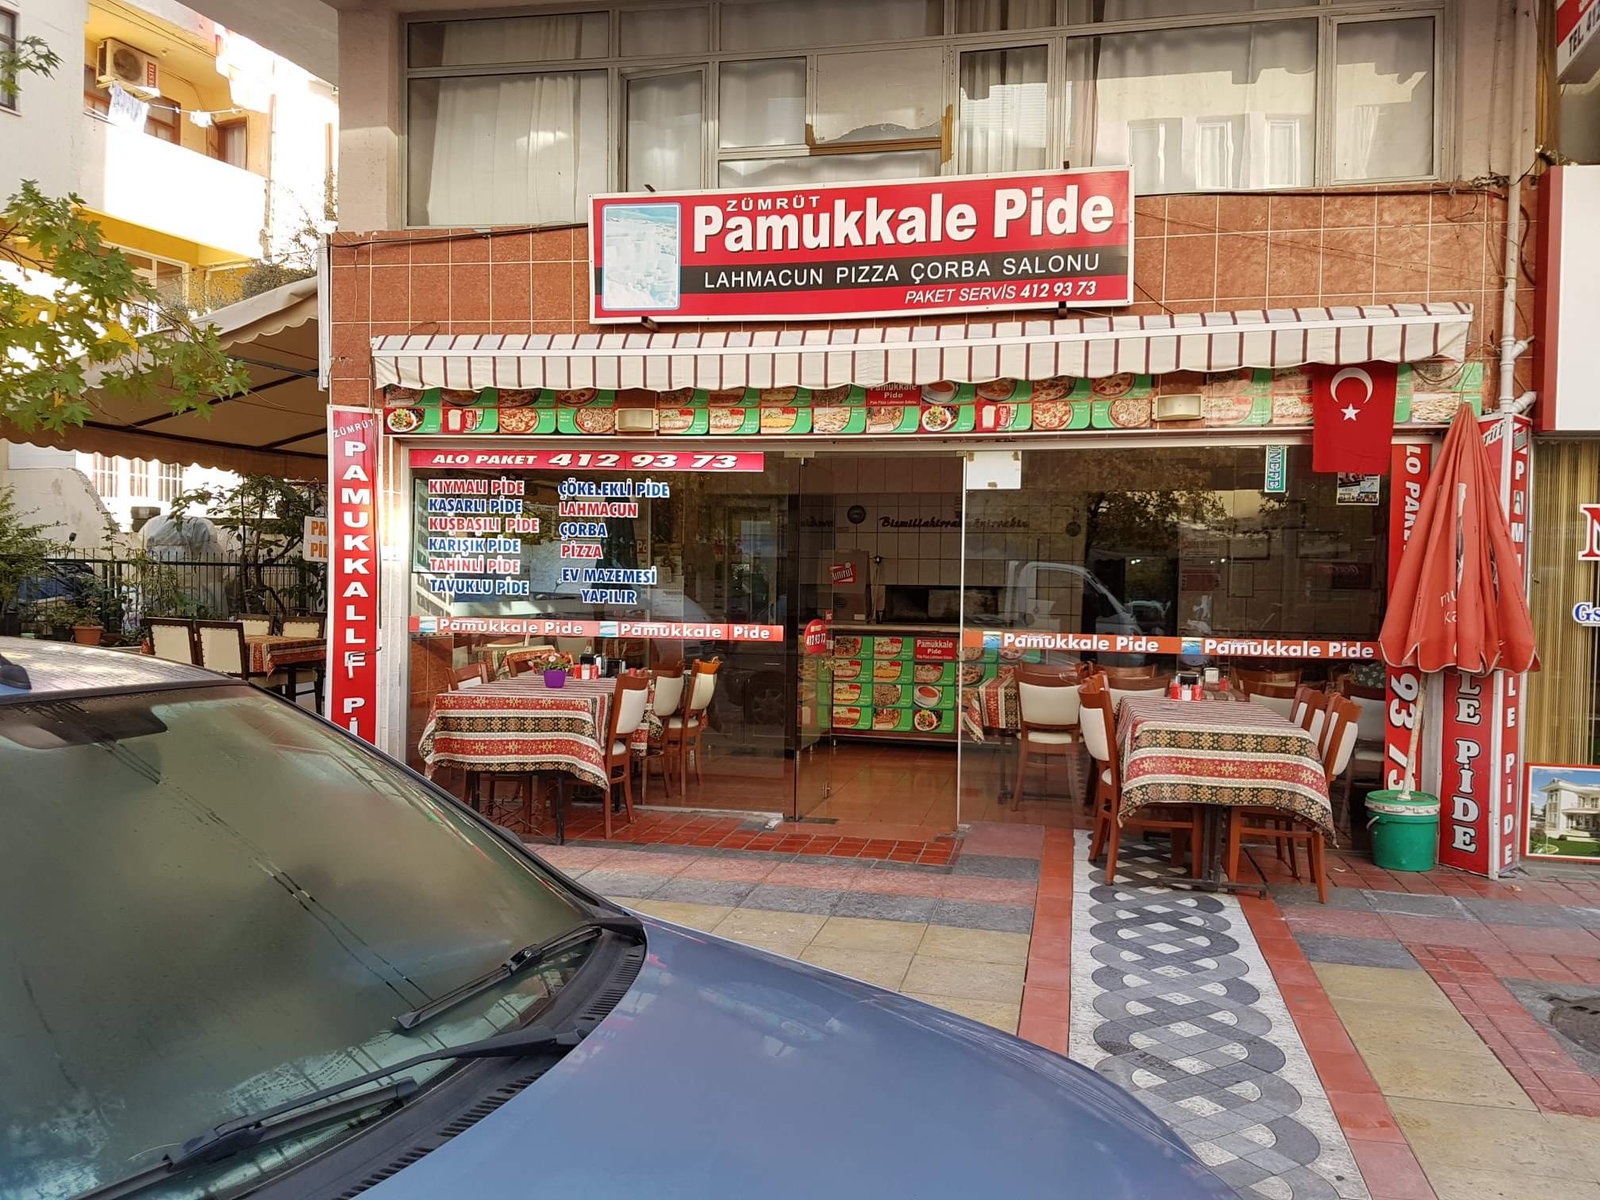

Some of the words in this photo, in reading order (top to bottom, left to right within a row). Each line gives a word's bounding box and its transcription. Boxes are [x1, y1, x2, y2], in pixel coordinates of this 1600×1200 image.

[726, 195, 821, 212] ZÜMRÜT
[694, 192, 978, 252] Pamukkale
[994, 184, 1114, 238] Pide
[704, 268, 823, 288] LAHMACUN
[836, 264, 899, 284] PIZZA
[910, 260, 991, 284] ÇORBA
[1002, 254, 1100, 276] SALONU
[904, 288, 956, 304] PAKET
[959, 284, 1016, 302] SERVİS
[1020, 283, 1049, 298] 412
[1053, 282, 1072, 296] 93
[1076, 280, 1097, 295] 73
[432, 454, 468, 464] ALO
[475, 455, 537, 464] PAKET
[548, 454, 620, 467] 412
[631, 454, 678, 468] 93
[689, 455, 738, 468] 73
[428, 480, 488, 494] KIYMALI
[491, 476, 524, 494] PİDE
[636, 479, 670, 497] PİDE
[490, 496, 522, 513] PİDE
[559, 502, 638, 518] LAHMACUN
[428, 517, 500, 536] KUŞBAŞILI
[506, 515, 539, 532] PİDE
[560, 523, 607, 540] ÇORBA
[428, 538, 486, 556] KARIŞIK
[488, 535, 520, 553] PİDE
[561, 540, 603, 558] PİZZA
[430, 555, 484, 573] TAHİNLİ
[487, 556, 519, 574] PİDE
[562, 568, 580, 582] EV
[583, 566, 657, 584] MAZEMESİ
[430, 579, 493, 593] TAVUKLU
[496, 577, 529, 595] PİDE
[582, 589, 637, 604] YAPILIR
[440, 618, 538, 634] Pamukkale
[544, 620, 583, 634] Pide
[620, 624, 722, 638] Pamukkale
[733, 626, 770, 639] Pide
[1004, 633, 1110, 650] Pamukkale
[1116, 634, 1159, 652] Pide
[1204, 640, 1322, 657] Pamukkale
[1328, 642, 1374, 658] Pide
[1452, 738, 1480, 854] PİDE
